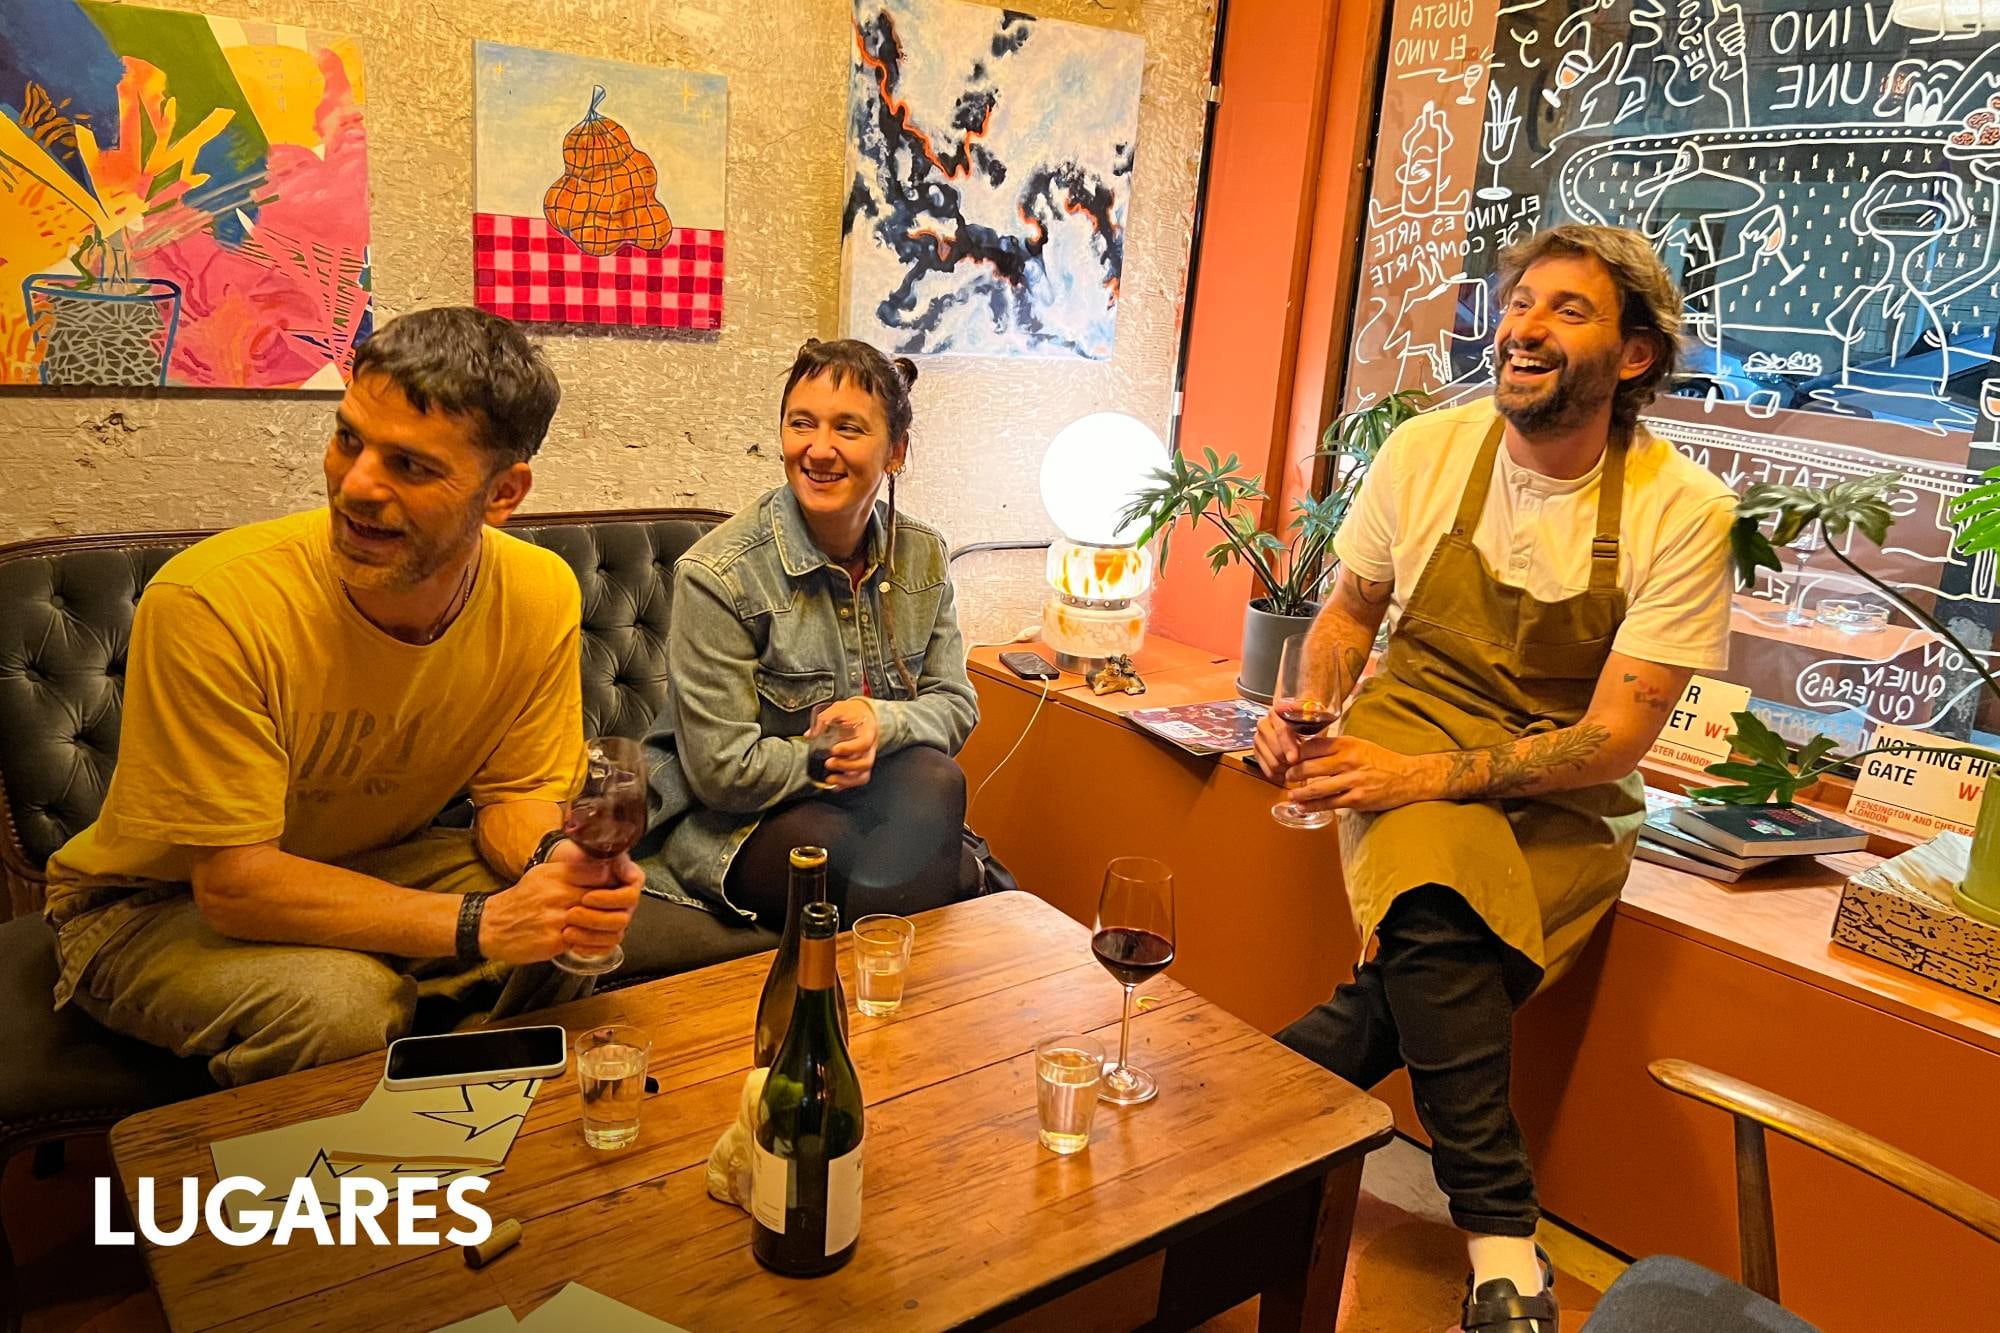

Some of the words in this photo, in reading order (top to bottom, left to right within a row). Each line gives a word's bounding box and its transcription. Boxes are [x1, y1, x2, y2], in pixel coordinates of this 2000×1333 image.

[1876, 736, 1963, 771] NOTTING
[1867, 760, 1917, 786] GATE
[1853, 808, 1889, 824] LONDON
[1855, 800, 1912, 821] KENSINGTON
[1913, 815, 1932, 827] AND
